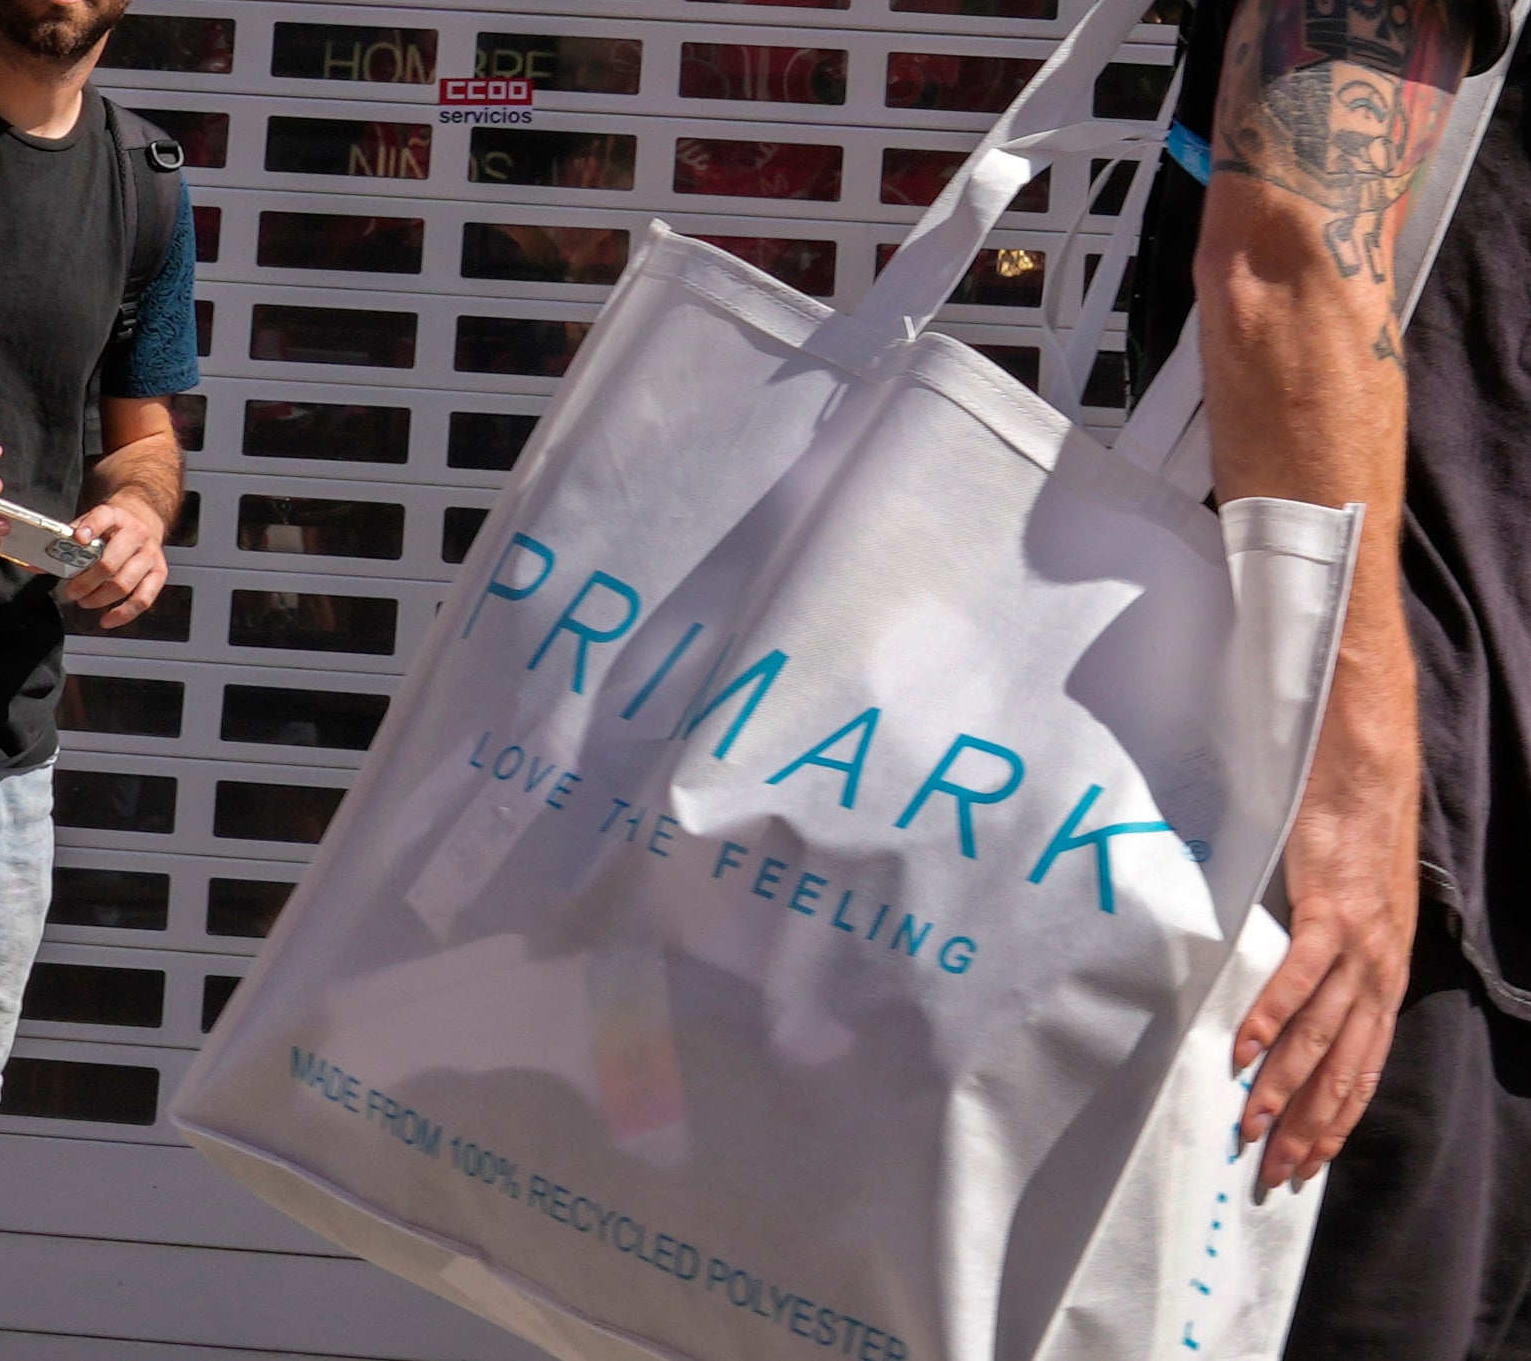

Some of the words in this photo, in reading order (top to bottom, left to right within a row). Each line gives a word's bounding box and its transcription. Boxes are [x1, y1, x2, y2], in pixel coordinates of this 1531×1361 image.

[439, 107, 533, 125] servicios
[445, 79, 529, 101] CCOO
[462, 531, 1175, 915] PRIMARK
[468, 731, 582, 812] LOVE
[712, 841, 979, 975] FEELING
[290, 1045, 361, 1114] MADE
[366, 1089, 444, 1159] FROM
[450, 1136, 522, 1200] 100%
[526, 1173, 701, 1281] RECYCLED
